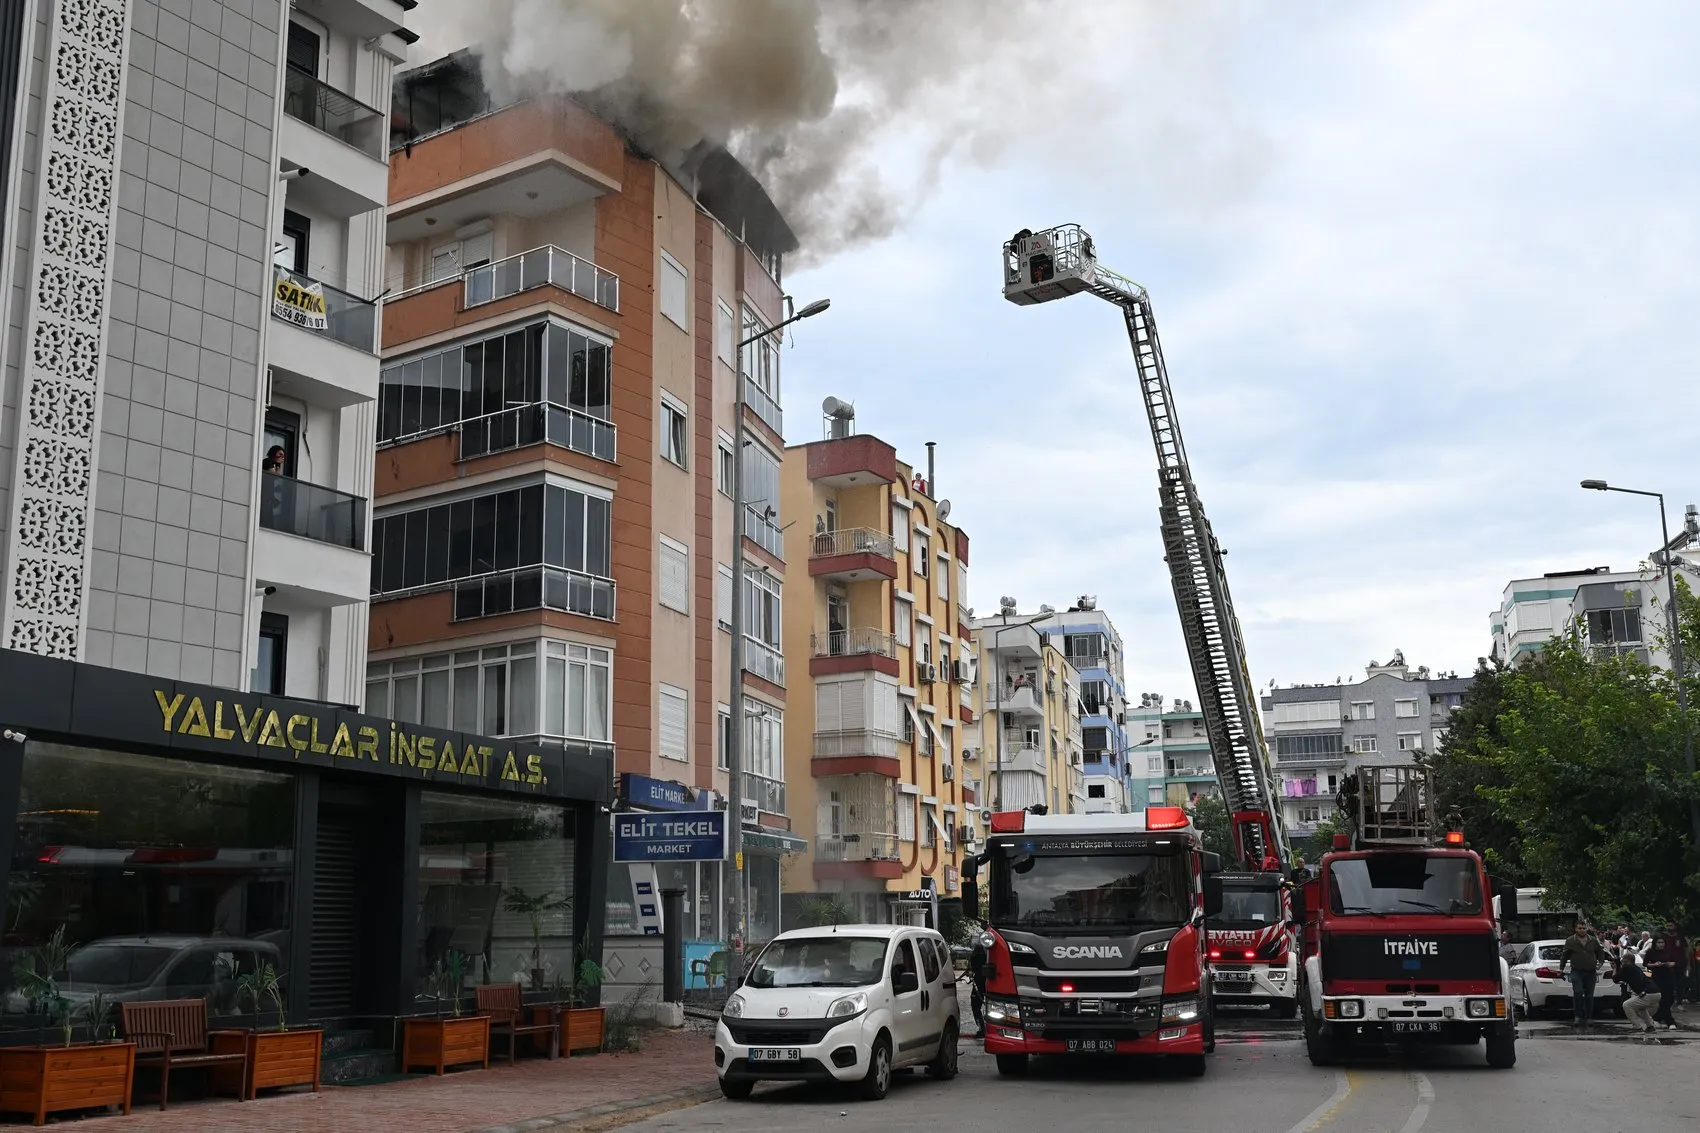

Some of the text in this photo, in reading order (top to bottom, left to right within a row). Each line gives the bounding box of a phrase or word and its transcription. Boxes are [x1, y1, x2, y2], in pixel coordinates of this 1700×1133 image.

[315, 318, 324, 328] 07
[153, 690, 547, 792] YALVAÇLAR İNŞAAT A.Ş.
[651, 784, 664, 800] ELİT
[620, 818, 719, 838] ELİT TEKEL
[647, 844, 692, 854] MARKET
[1042, 842, 1069, 850] ANTALYA
[1070, 840, 1113, 849] BÜYÜKŞEHİR
[908, 889, 931, 898] AUTO
[1384, 938, 1438, 955] İTFAİYE
[1053, 946, 1123, 958] SCANIA
[1396, 1023, 1405, 1031] 07
[1068, 1040, 1113, 1049] 07 ABB 024
[754, 1050, 763, 1059] 07
[787, 1050, 798, 1059] 58
